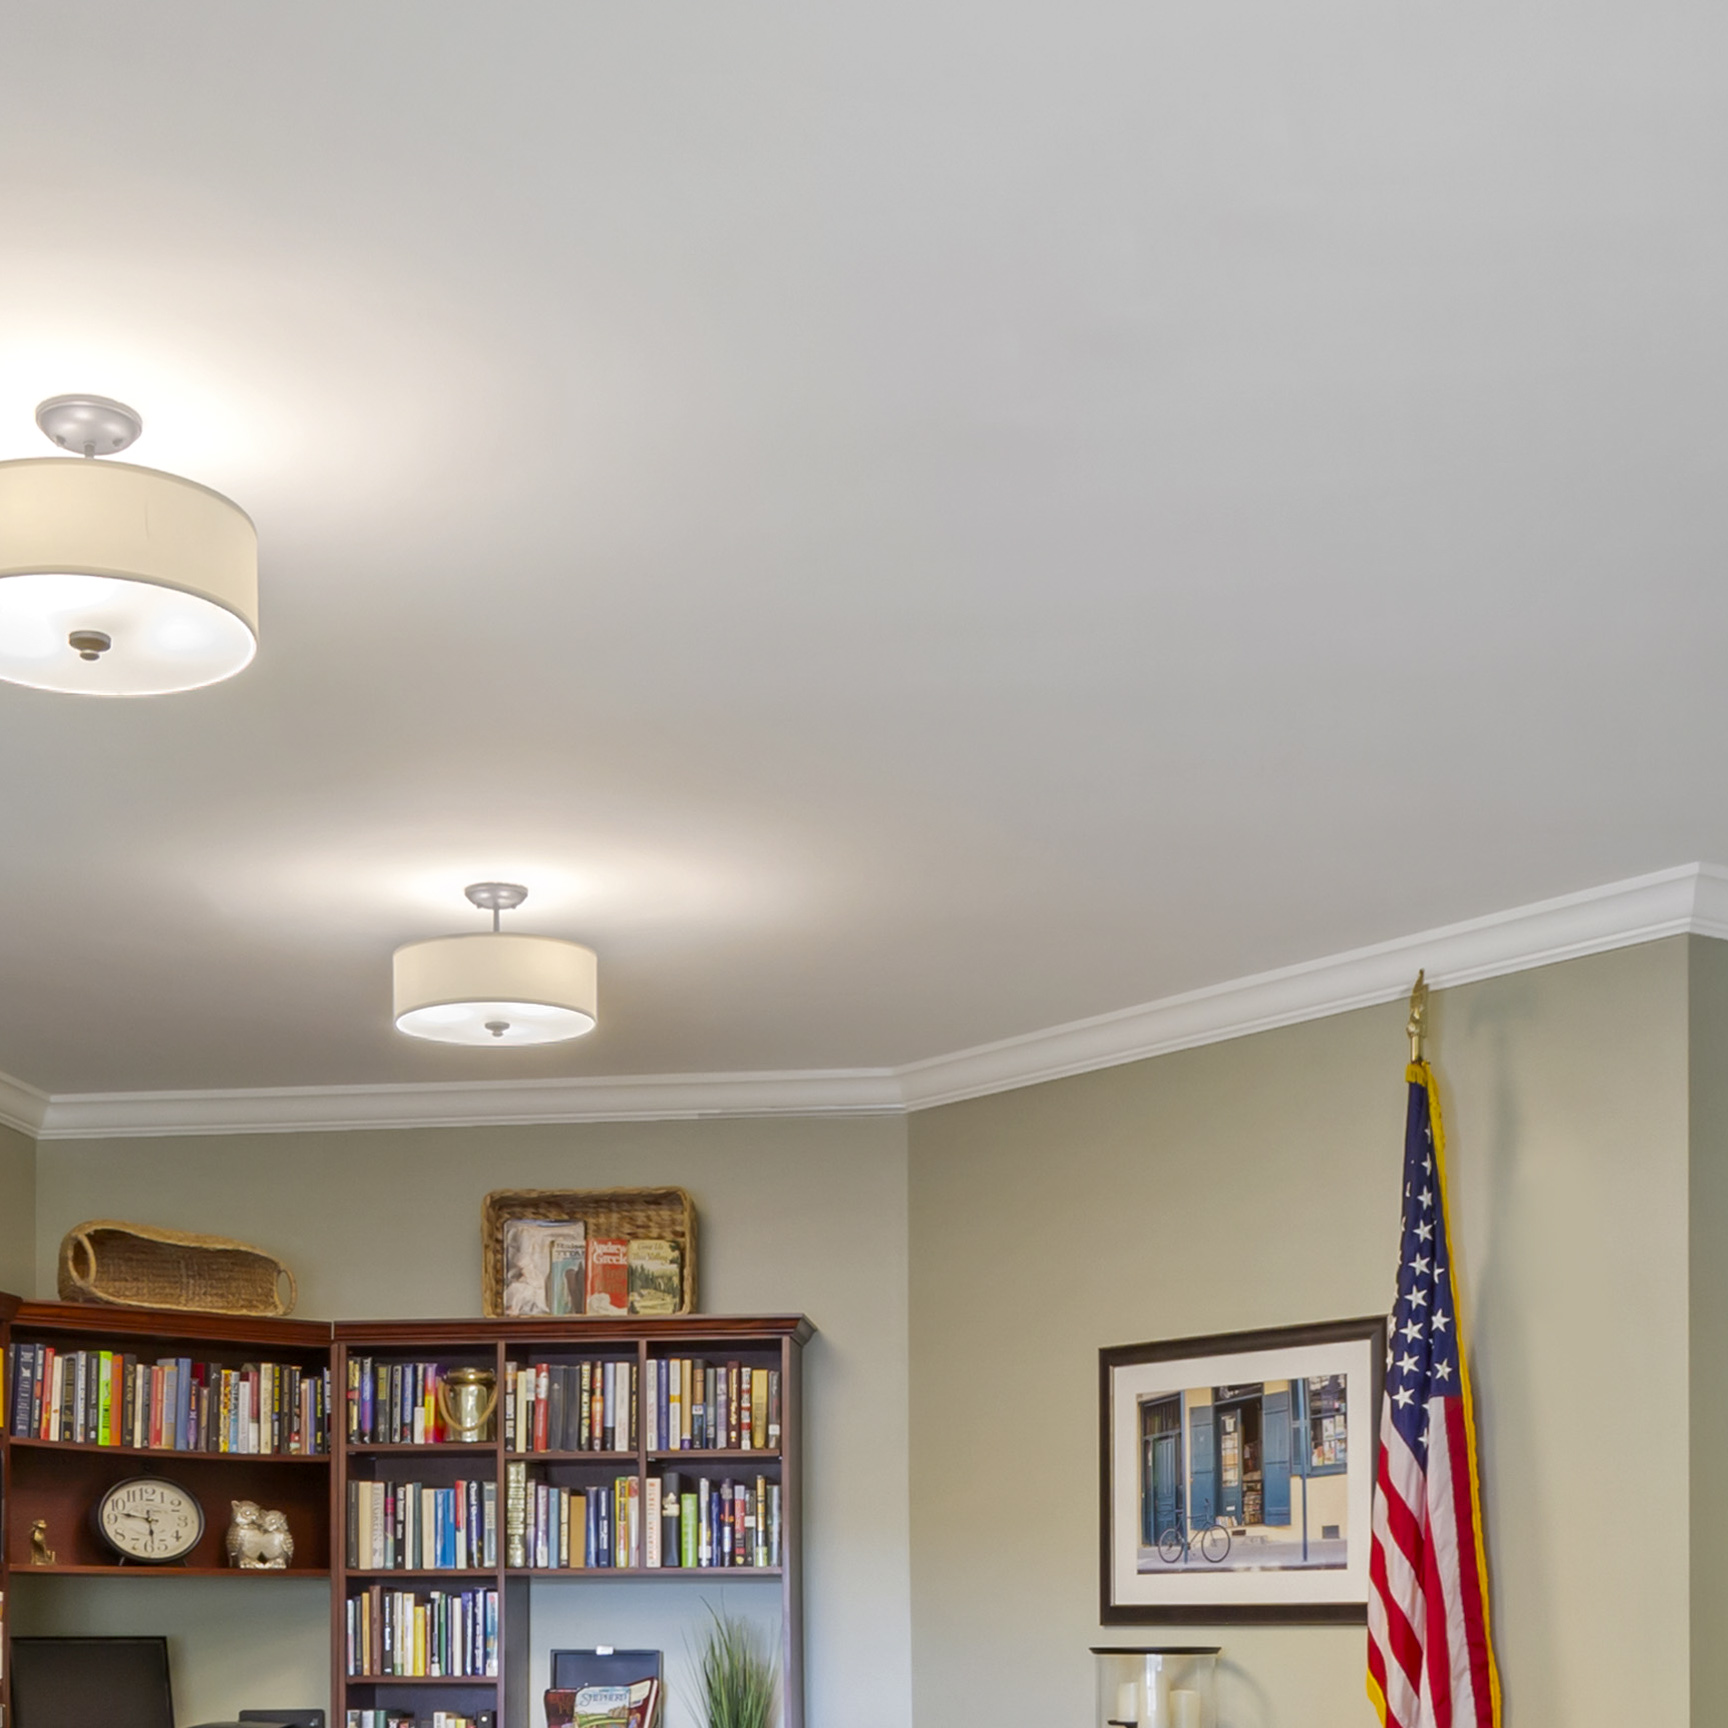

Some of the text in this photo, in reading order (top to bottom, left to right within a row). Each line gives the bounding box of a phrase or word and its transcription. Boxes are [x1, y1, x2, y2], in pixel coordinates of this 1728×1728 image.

[126, 1490, 136, 1503] 11
[138, 1487, 156, 1502] 12
[111, 1498, 126, 1512] 10
[169, 1498, 182, 1513] 2
[106, 1513, 118, 1525] 9
[176, 1515, 188, 1528] 3
[114, 1528, 126, 1542] 8
[171, 1530, 182, 1542] 4
[130, 1537, 140, 1551] 7
[143, 1540, 155, 1553] 6
[156, 1538, 168, 1552] 5
